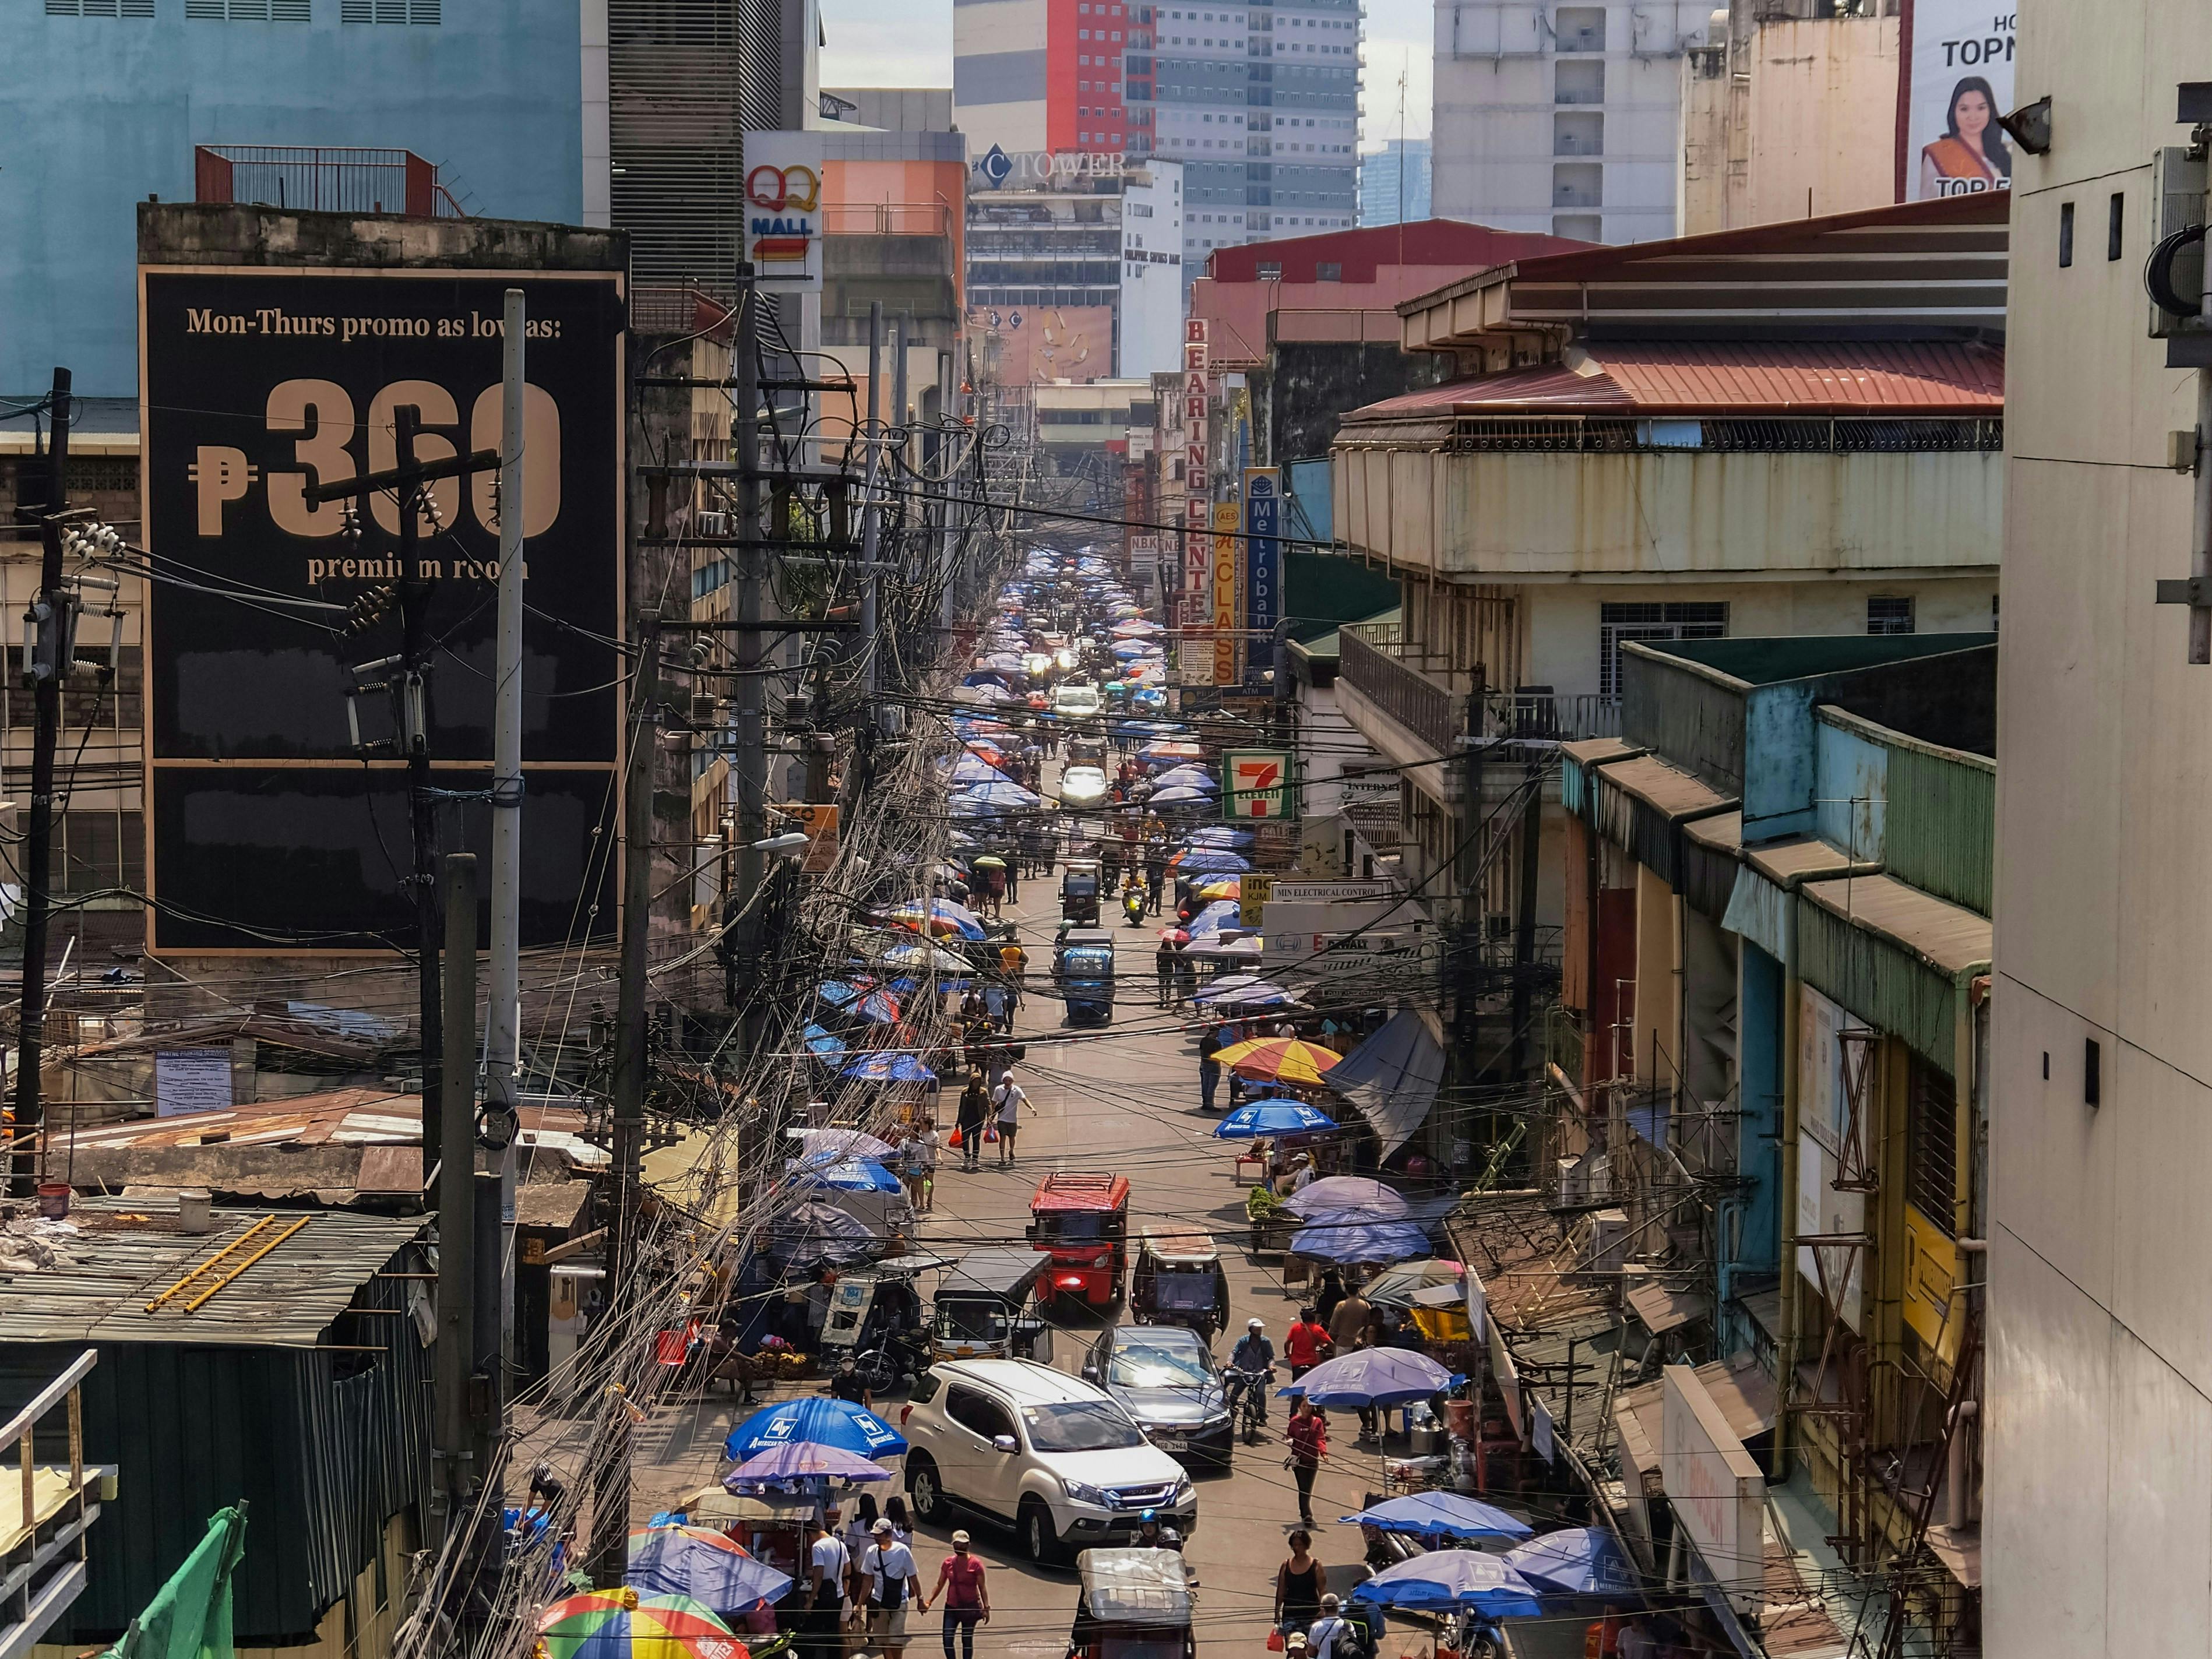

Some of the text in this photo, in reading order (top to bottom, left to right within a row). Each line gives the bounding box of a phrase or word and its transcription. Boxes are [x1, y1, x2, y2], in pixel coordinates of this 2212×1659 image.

[1013, 152, 1128, 178] TOWER
[747, 165, 817, 212] QQ
[752, 218, 813, 234] MALL
[186, 308, 335, 336] Mon-Thurs
[341, 316, 430, 341] promo
[437, 317, 464, 337] as
[526, 319, 561, 338] as:
[1188, 321, 1206, 489] BEARING
[453, 558, 529, 580] roo
[1239, 763, 1278, 816] 7
[1248, 892, 1267, 901] KJM
[1277, 889, 1292, 897] MIN
[1294, 888, 1340, 897] ELECTRICAL
[1328, 939, 1369, 950] DWALT
